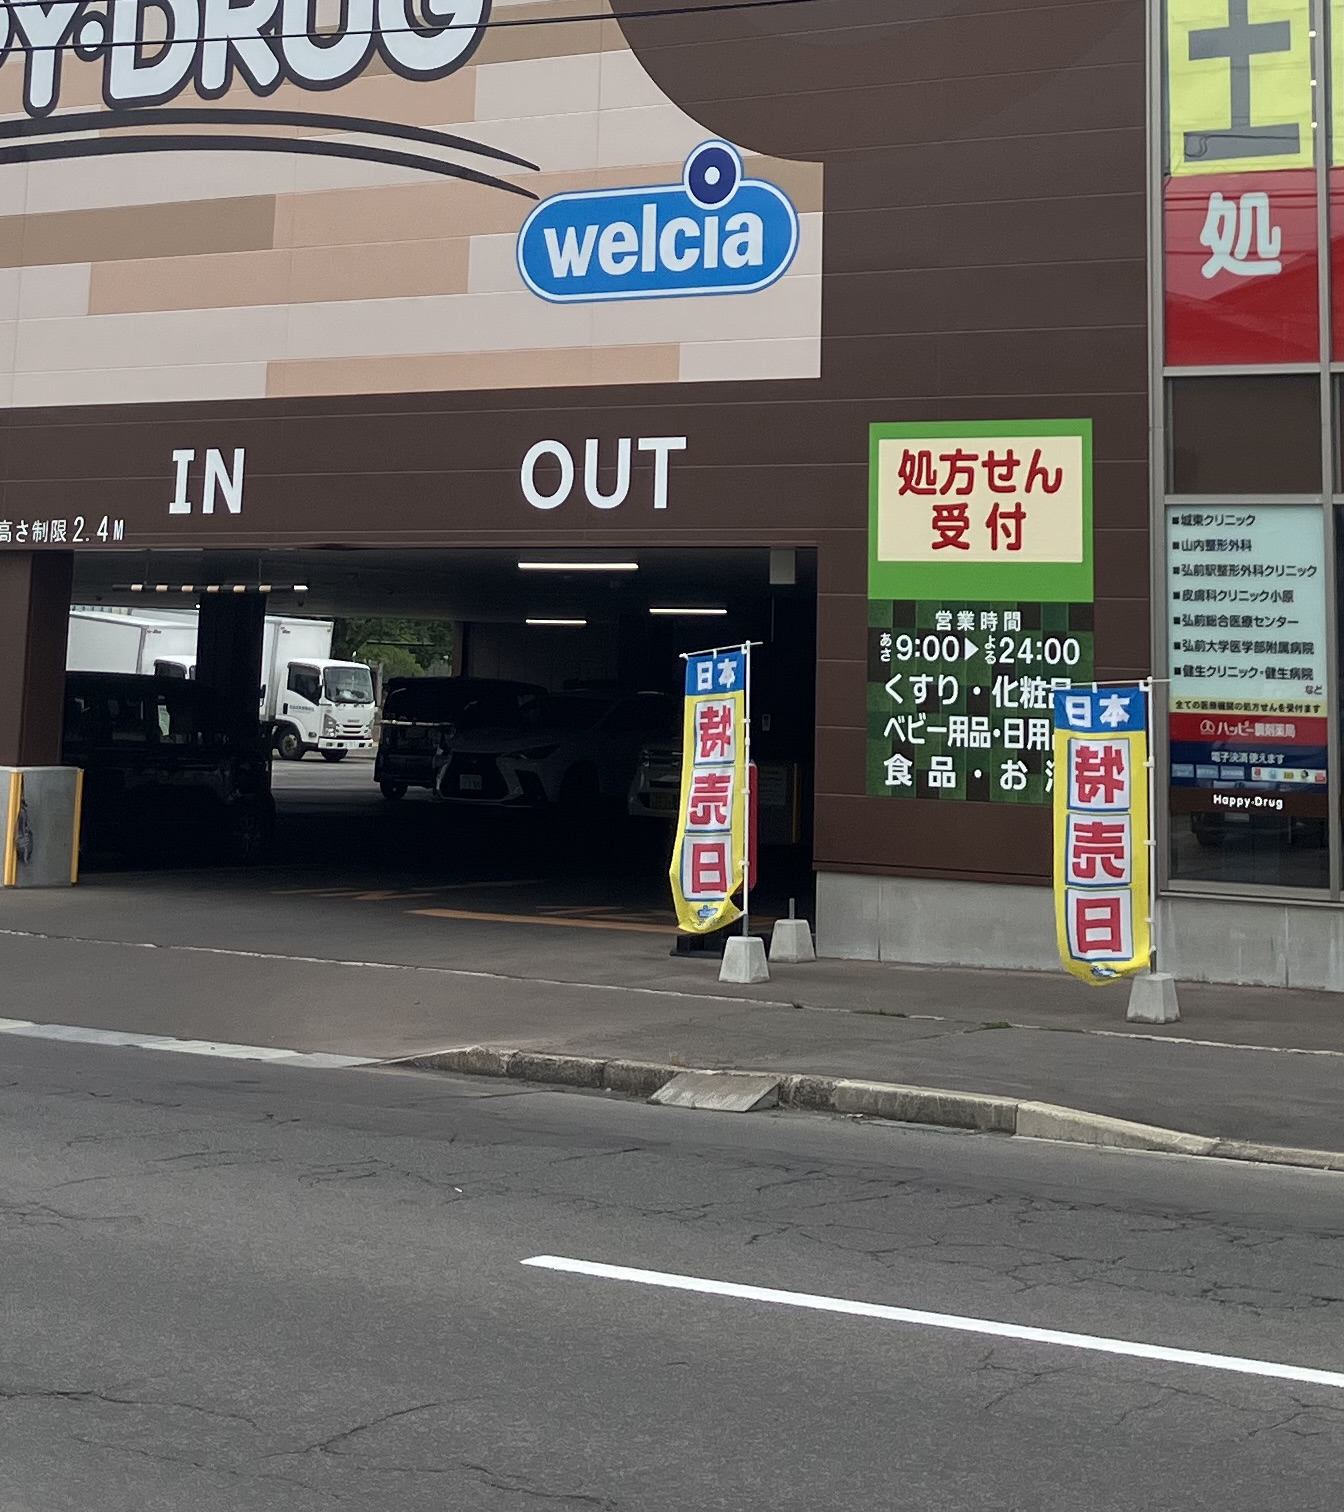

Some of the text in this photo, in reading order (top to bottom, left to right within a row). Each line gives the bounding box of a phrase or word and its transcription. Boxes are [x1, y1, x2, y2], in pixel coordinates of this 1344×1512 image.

[542, 203, 765, 278] welcia
[169, 448, 246, 516] IN
[520, 436, 688, 510] OUT
[897, 448, 1063, 496] 処方せん
[930, 502, 1027, 552] 受付
[935, 610, 1023, 632] 営業時間
[880, 632, 1081, 665] あさ 9:00 よる 24:00
[883, 713, 1056, 752] ベビー用品・日用
